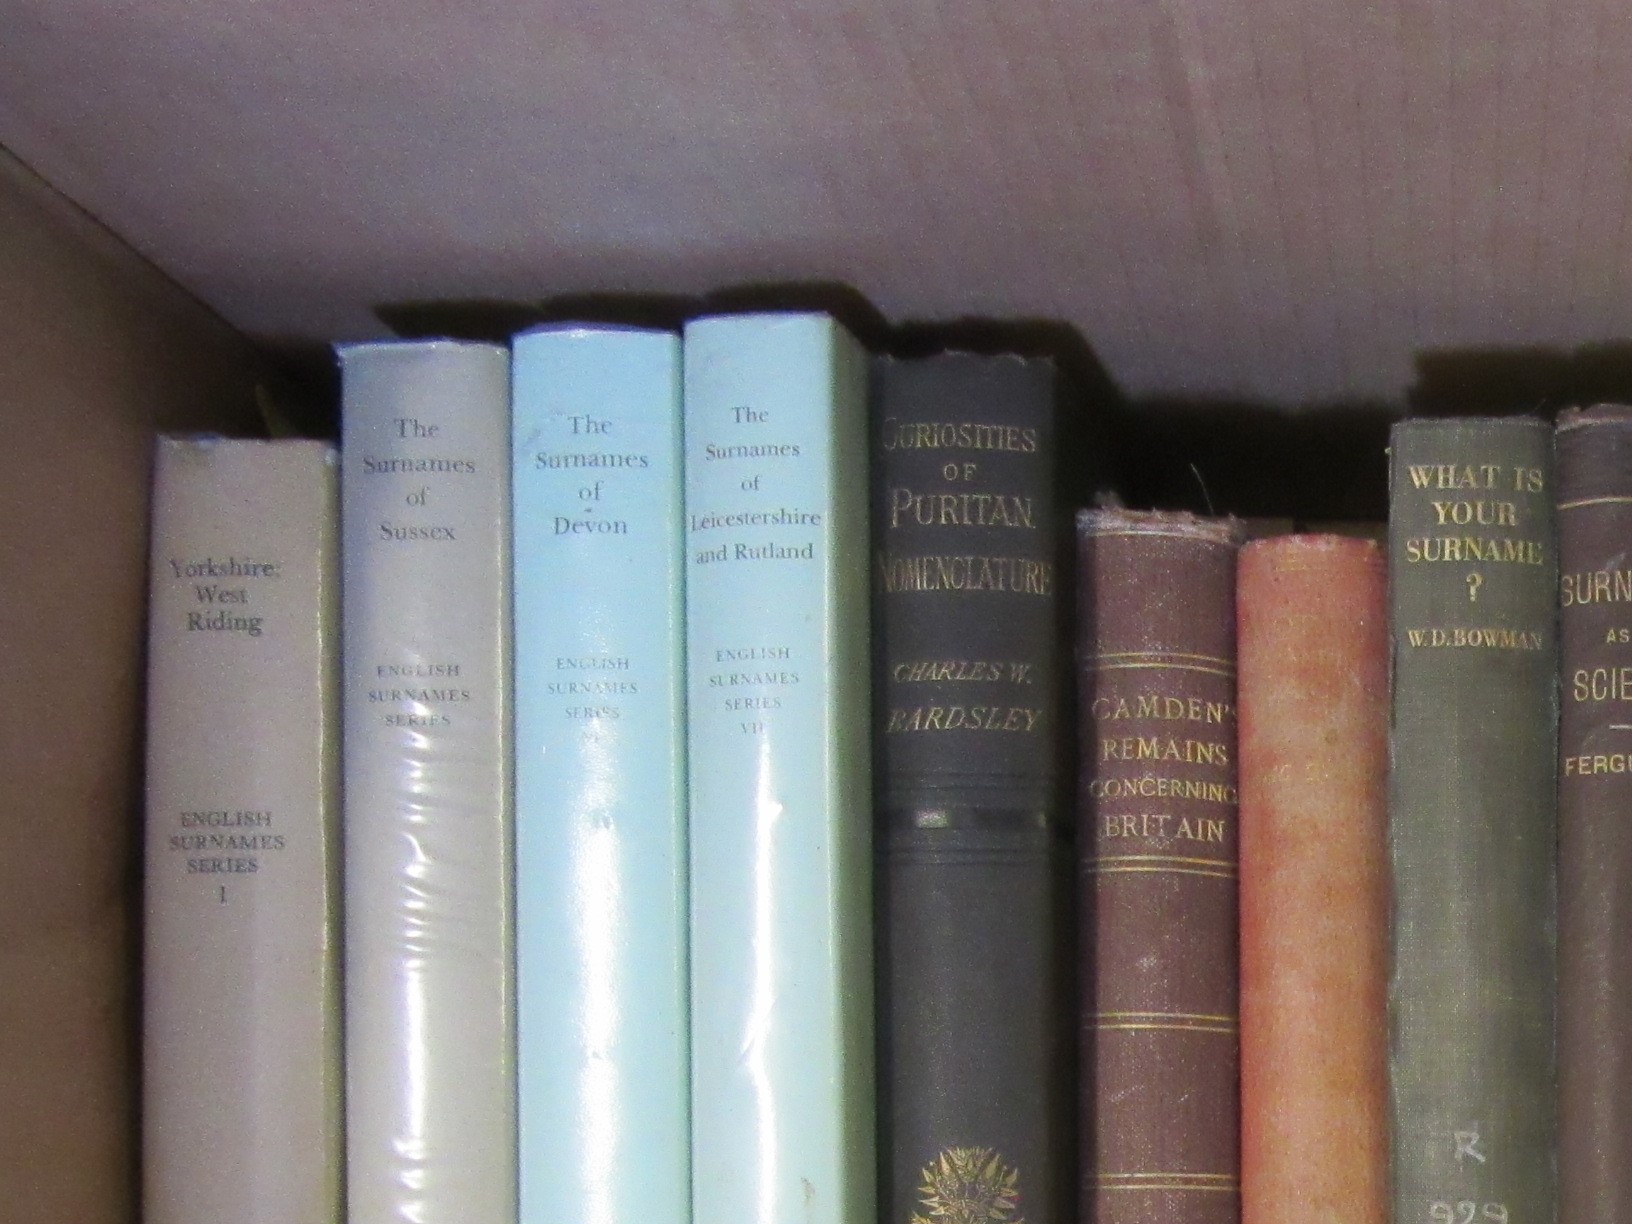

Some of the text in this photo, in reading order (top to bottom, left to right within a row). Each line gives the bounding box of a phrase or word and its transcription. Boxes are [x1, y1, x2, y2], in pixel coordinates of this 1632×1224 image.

[567, 414, 613, 435] The
[732, 405, 769, 425] The
[395, 418, 439, 438] The
[536, 452, 649, 470] Surnames
[705, 444, 801, 461] Surnames
[362, 456, 476, 475] Surnames
[944, 463, 976, 481] OF
[741, 475, 761, 491] of
[1406, 465, 1543, 493] WHAT IS
[406, 485, 430, 506] of
[579, 480, 604, 501] of
[890, 488, 1036, 529] PURITAN
[1431, 501, 1517, 527] YOUR
[554, 516, 628, 536] Devon
[691, 508, 822, 533] Leicestershire
[380, 522, 457, 542] Sussex
[696, 543, 814, 565] and Rutland
[1406, 538, 1543, 565] SURNAME
[196, 585, 248, 605] West
[187, 611, 264, 637] Riding
[1606, 627, 1630, 644] AS
[556, 657, 630, 671] ENGLISH
[716, 647, 790, 662] ENGLISH
[377, 664, 460, 679] ENGLISH
[709, 672, 799, 688] SURNAMES
[894, 661, 1000, 682] CHARLES
[368, 689, 471, 703] SURNAMES
[548, 682, 638, 696] SURNAMES
[725, 697, 782, 711] SERIES
[1092, 696, 1236, 723] CAMDEN'
[1102, 737, 1229, 766] REMAINS
[1090, 777, 1237, 804] CONCERNING
[181, 811, 272, 828] ENGLISH
[1105, 814, 1225, 842] BRITAIN
[170, 834, 287, 850] SURNAMES
[187, 858, 258, 874] SERIES
[1454, 1130, 1486, 1163] R
